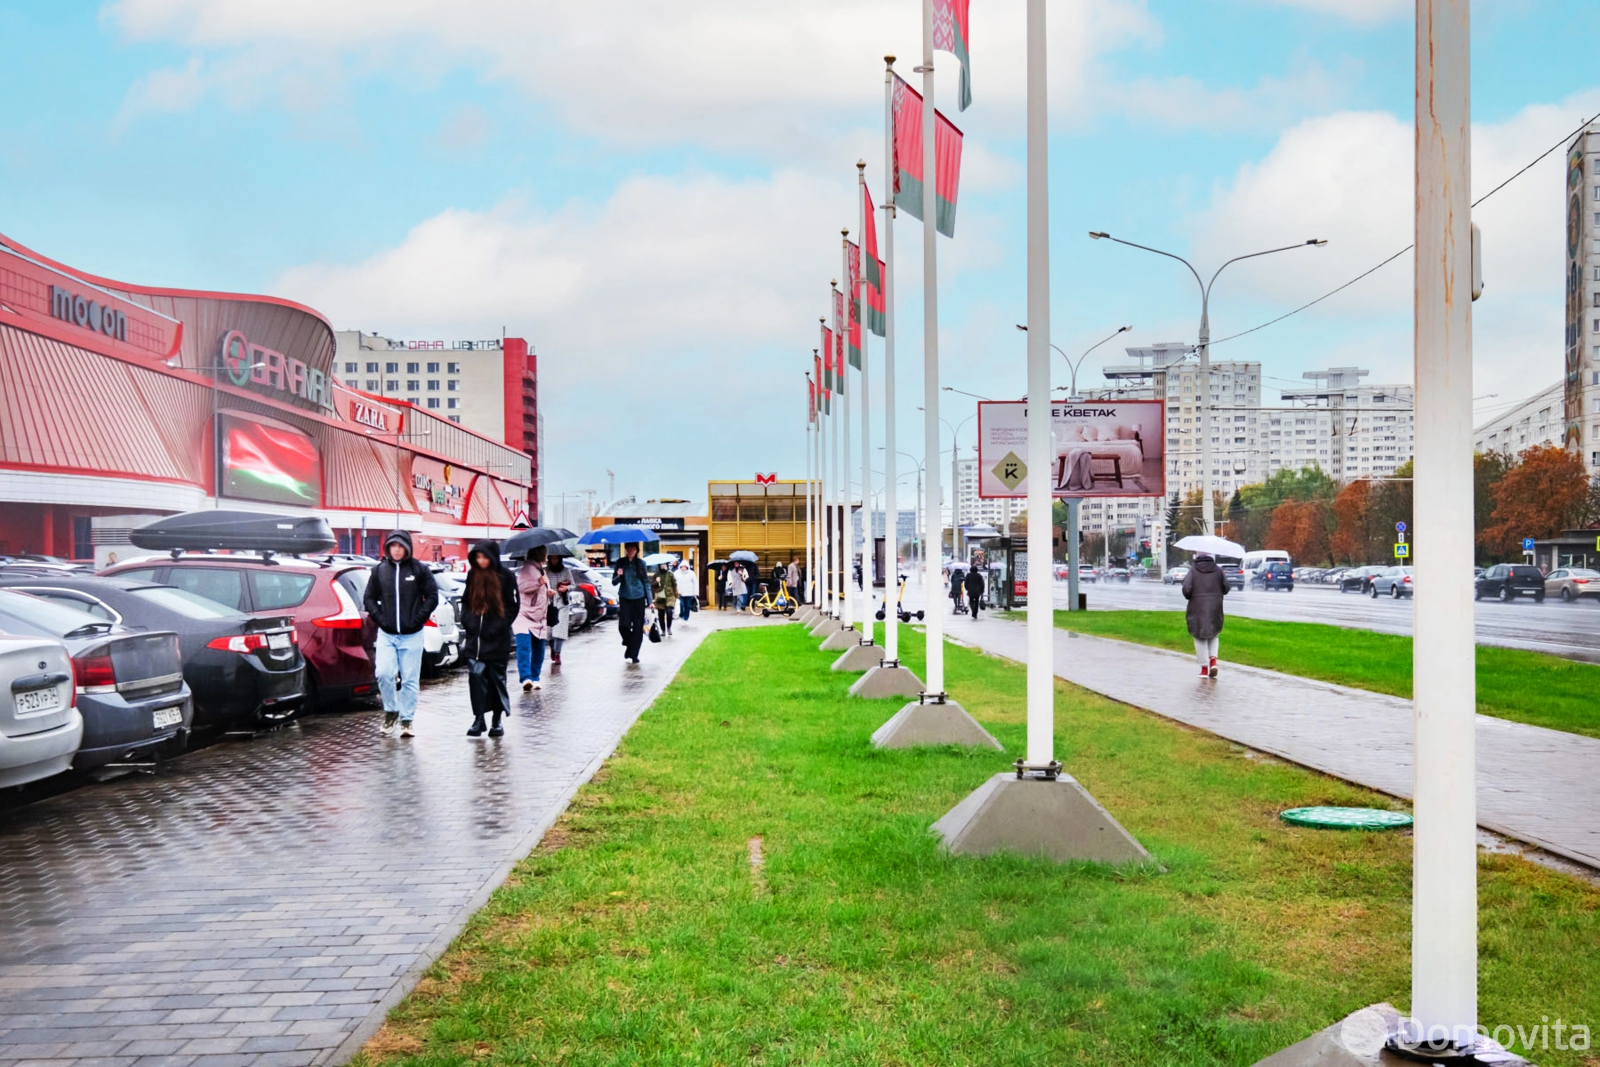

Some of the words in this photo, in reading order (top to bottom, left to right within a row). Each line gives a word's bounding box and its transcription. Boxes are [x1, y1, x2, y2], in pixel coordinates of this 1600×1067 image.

[408, 340, 444, 350] ДАНА
[354, 402, 386, 431] ZARA
[1063, 406, 1117, 417] КВЕТАК
